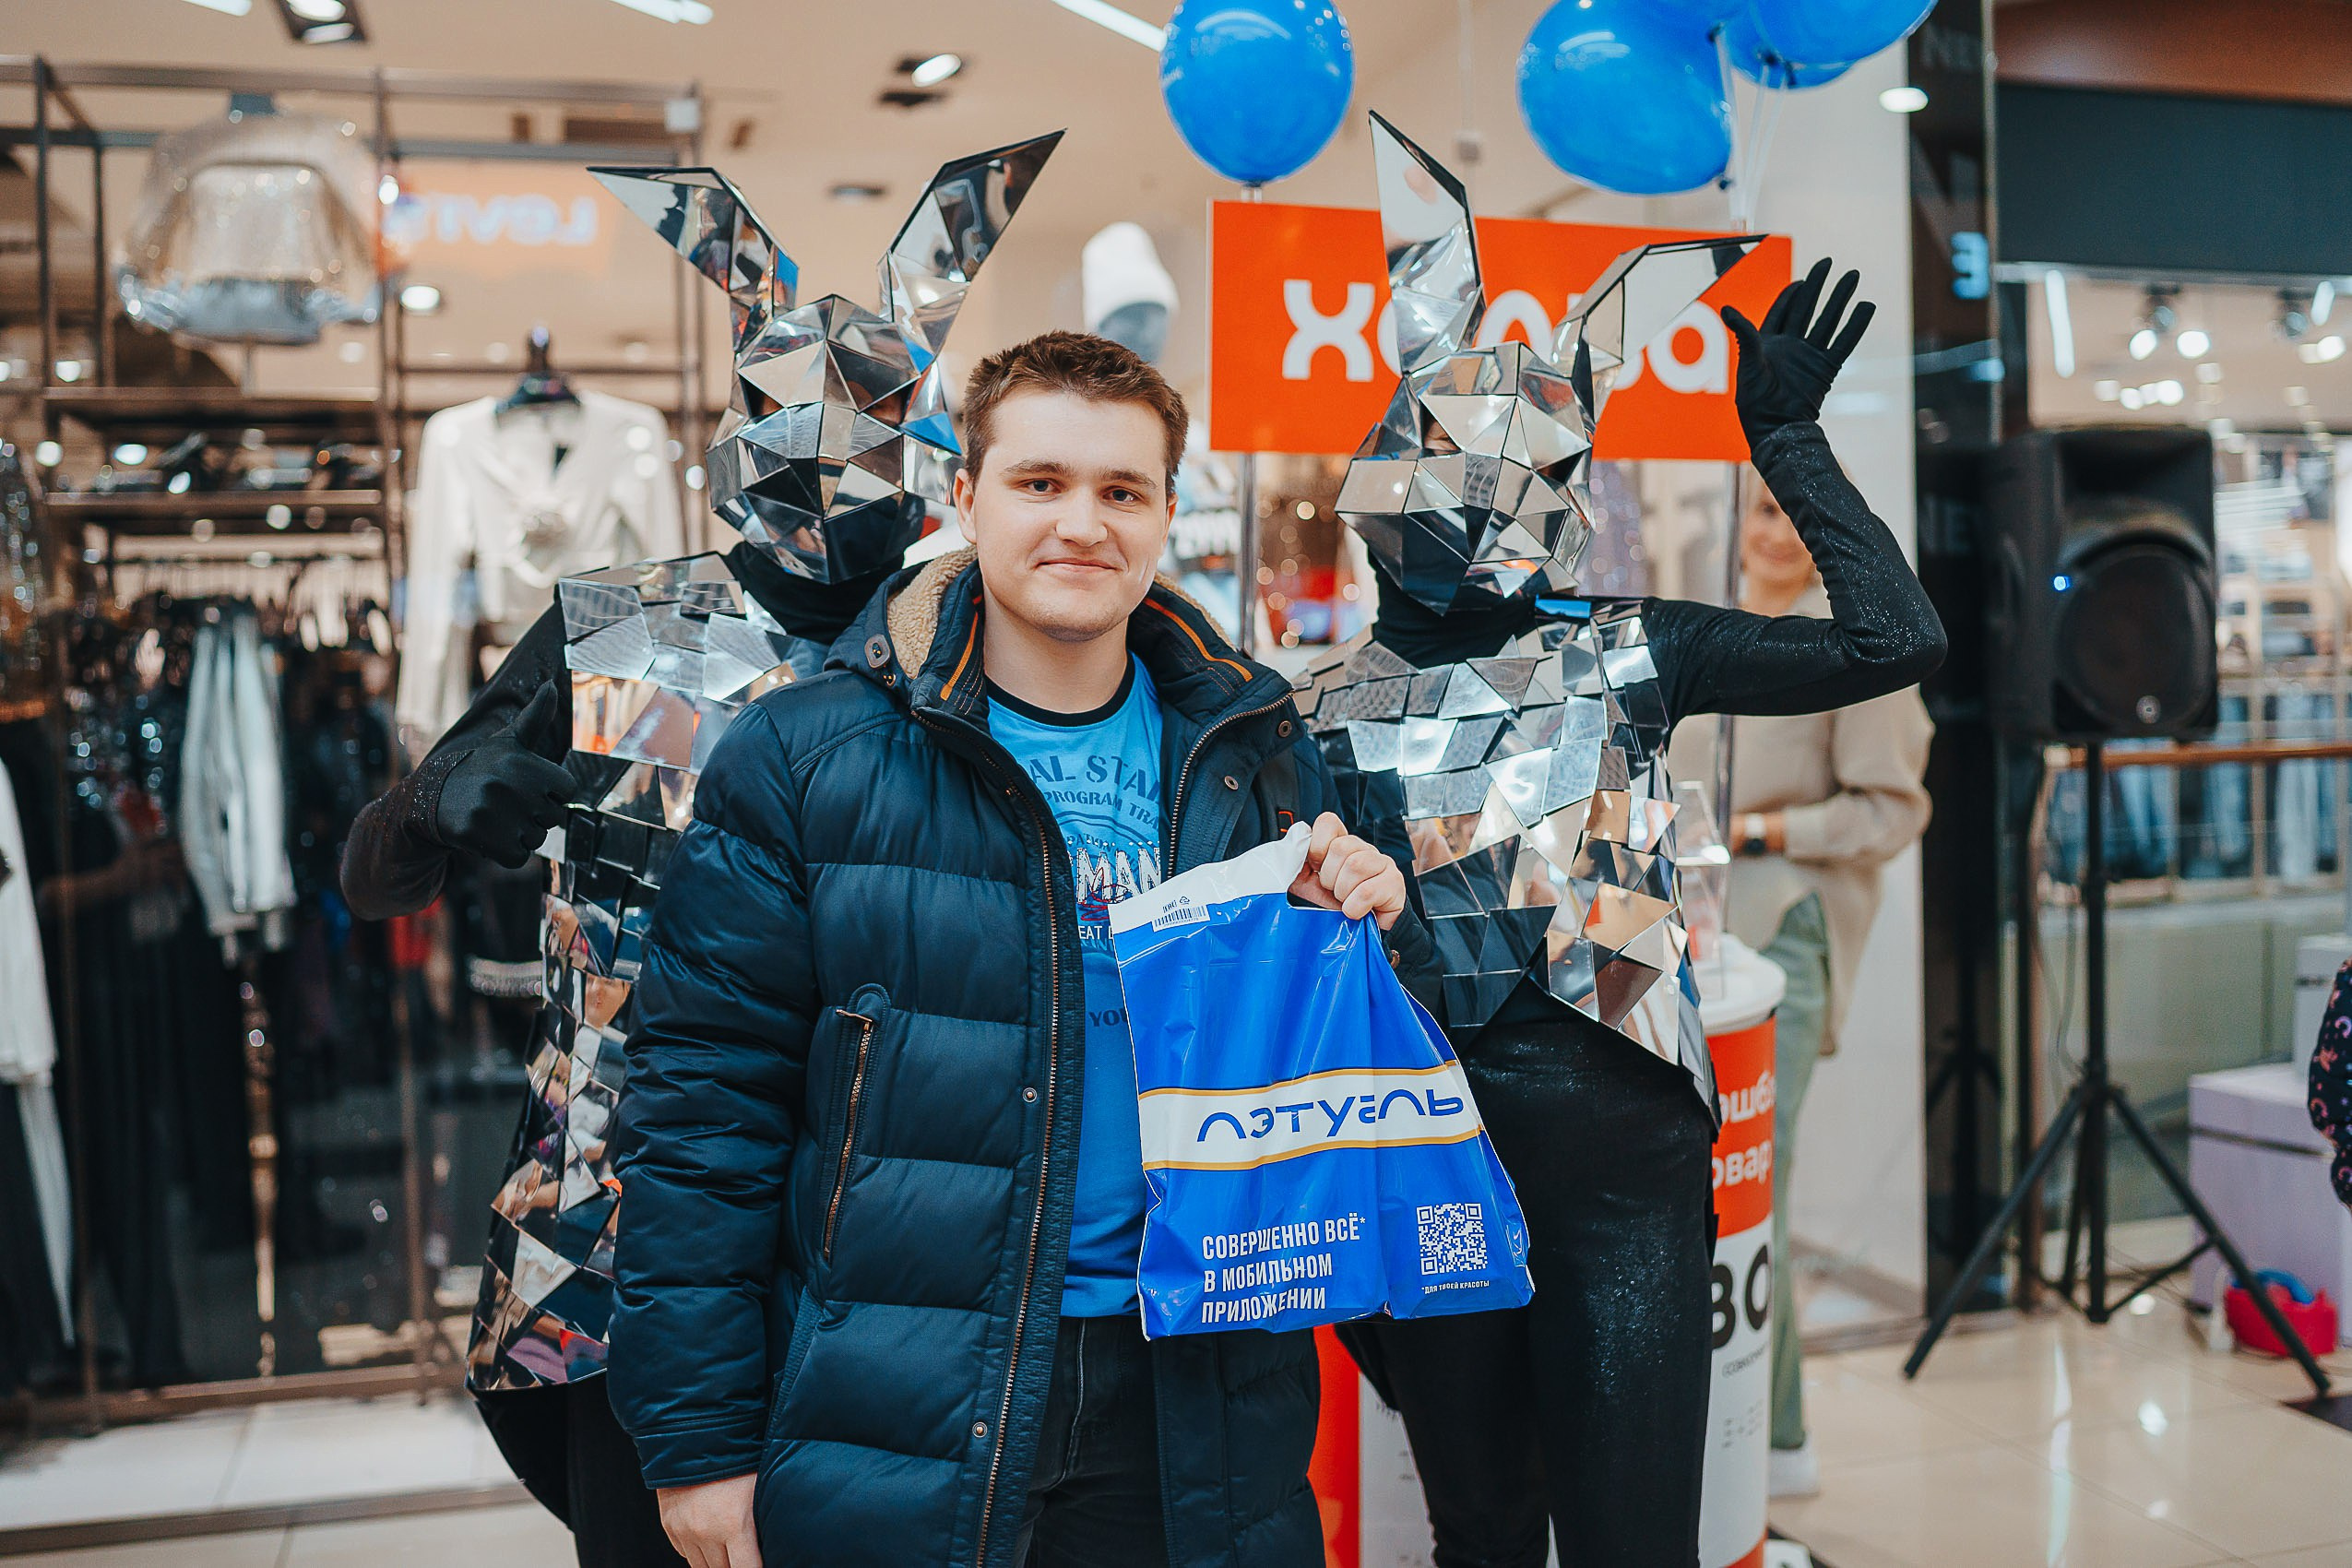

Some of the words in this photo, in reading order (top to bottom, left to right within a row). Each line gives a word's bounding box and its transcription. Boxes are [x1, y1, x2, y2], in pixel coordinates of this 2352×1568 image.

[1282, 279, 1730, 395] хла
[1067, 847, 1161, 903] MAN
[1078, 925, 1103, 940] EAT
[1202, 1221, 1319, 1260] СОВЕРШЕННО
[1204, 1269, 1217, 1293] В
[1222, 1253, 1333, 1292] МОБИЛЬНОМ
[1438, 1281, 1459, 1291] ТВОЕЙ
[1459, 1279, 1490, 1289] КРАСОТЫ
[1201, 1287, 1325, 1324] ПРИЛОЖЕНИИ
